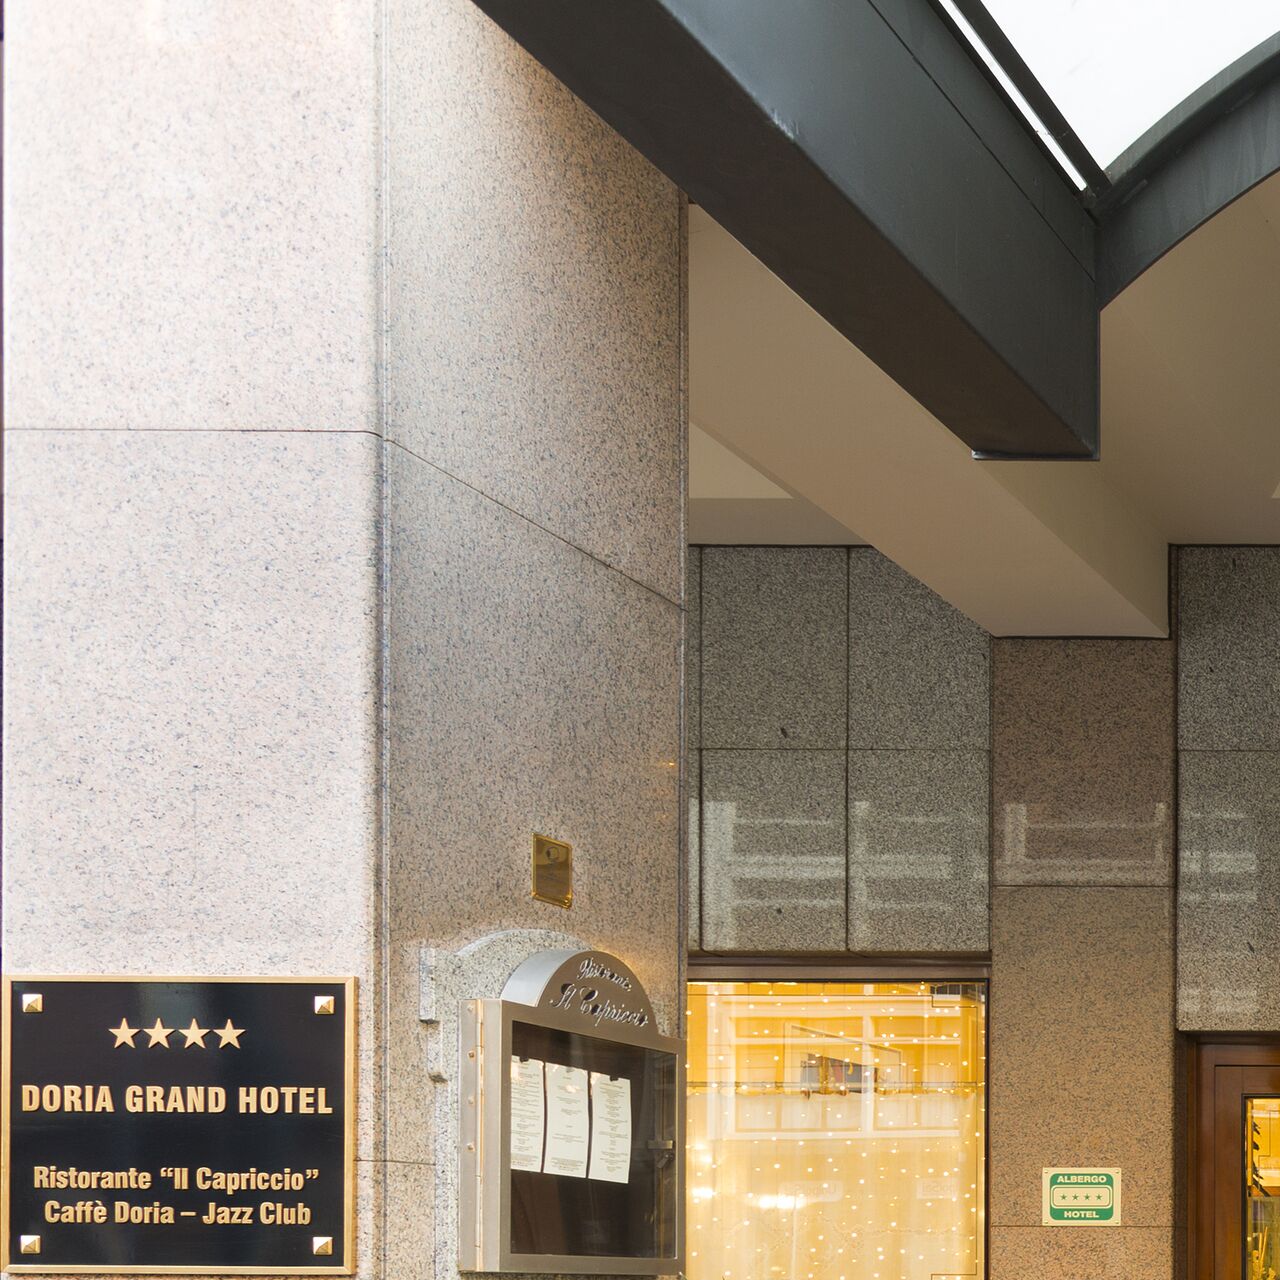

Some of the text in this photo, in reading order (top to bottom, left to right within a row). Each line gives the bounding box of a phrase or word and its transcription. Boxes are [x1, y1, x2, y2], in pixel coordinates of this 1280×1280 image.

[579, 985, 648, 1027] Capriccio
[21, 1084, 333, 1114] DORIA GRAND HOTEL
[33, 1166, 152, 1190] Ristorante
[1057, 1175, 1107, 1183] ALBERGO
[44, 1200, 108, 1224] Caffè
[113, 1202, 175, 1224] Doria
[202, 1203, 253, 1225] Jazz
[259, 1203, 312, 1225] Club
[1063, 1210, 1099, 1218] HOTEL
